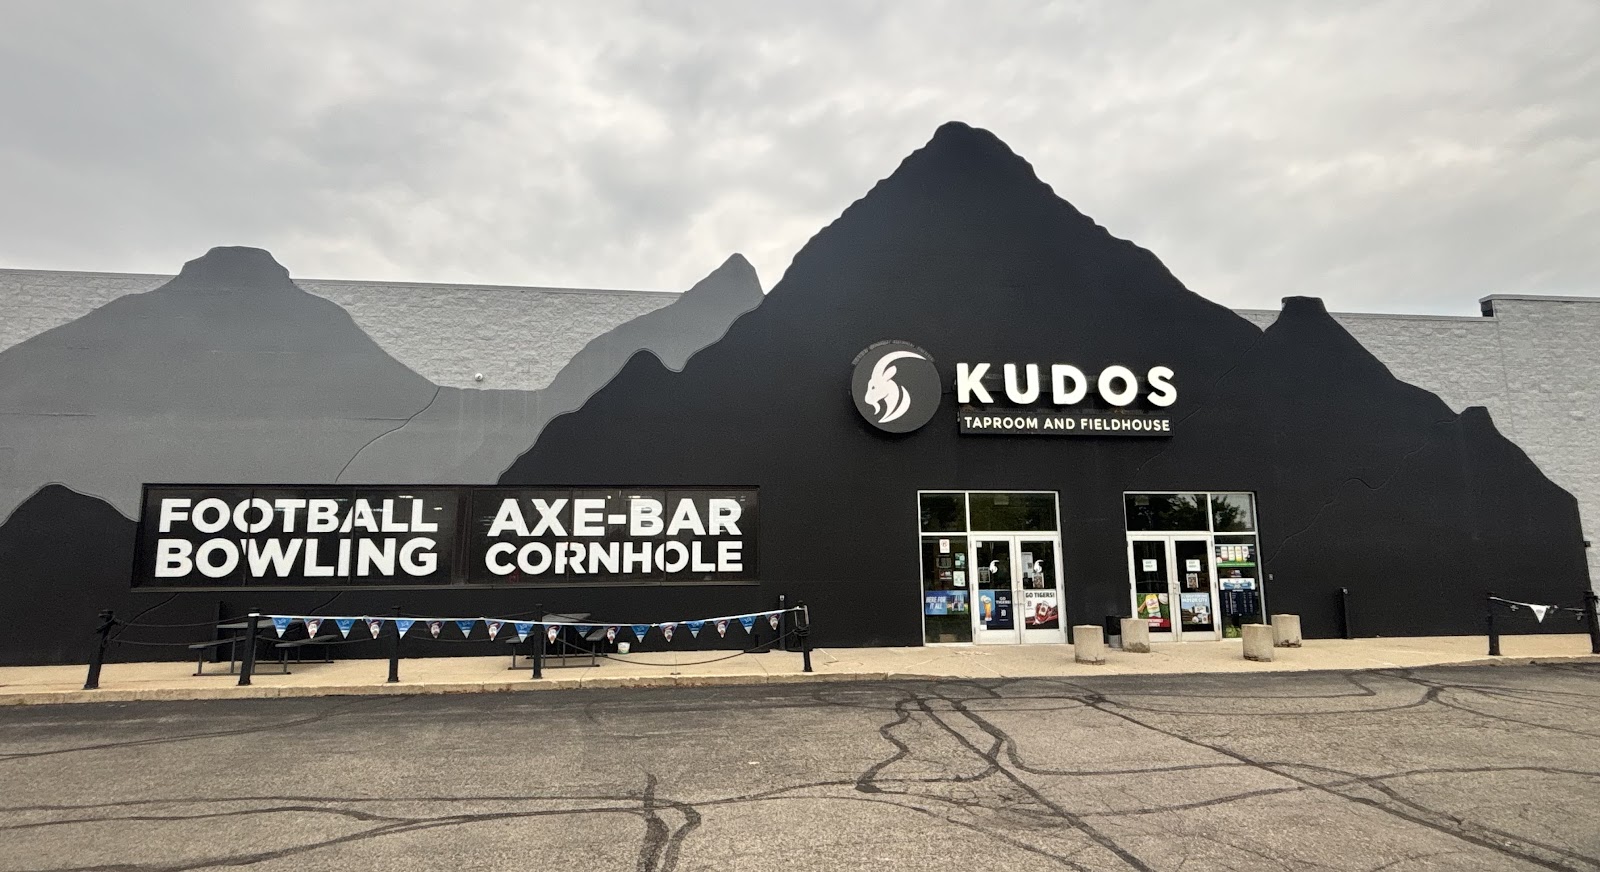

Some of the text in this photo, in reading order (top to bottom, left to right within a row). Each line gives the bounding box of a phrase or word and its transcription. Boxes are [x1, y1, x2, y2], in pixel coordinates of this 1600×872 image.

[956, 362, 1178, 407] KUDOS
[964, 416, 1171, 432] TAPROOM AND FIELDHOUSE
[158, 498, 439, 534] FOOTBALL
[486, 498, 743, 537] AXE-BAR
[154, 537, 438, 578] BOWLING
[485, 541, 743, 576] CORNHOLE
